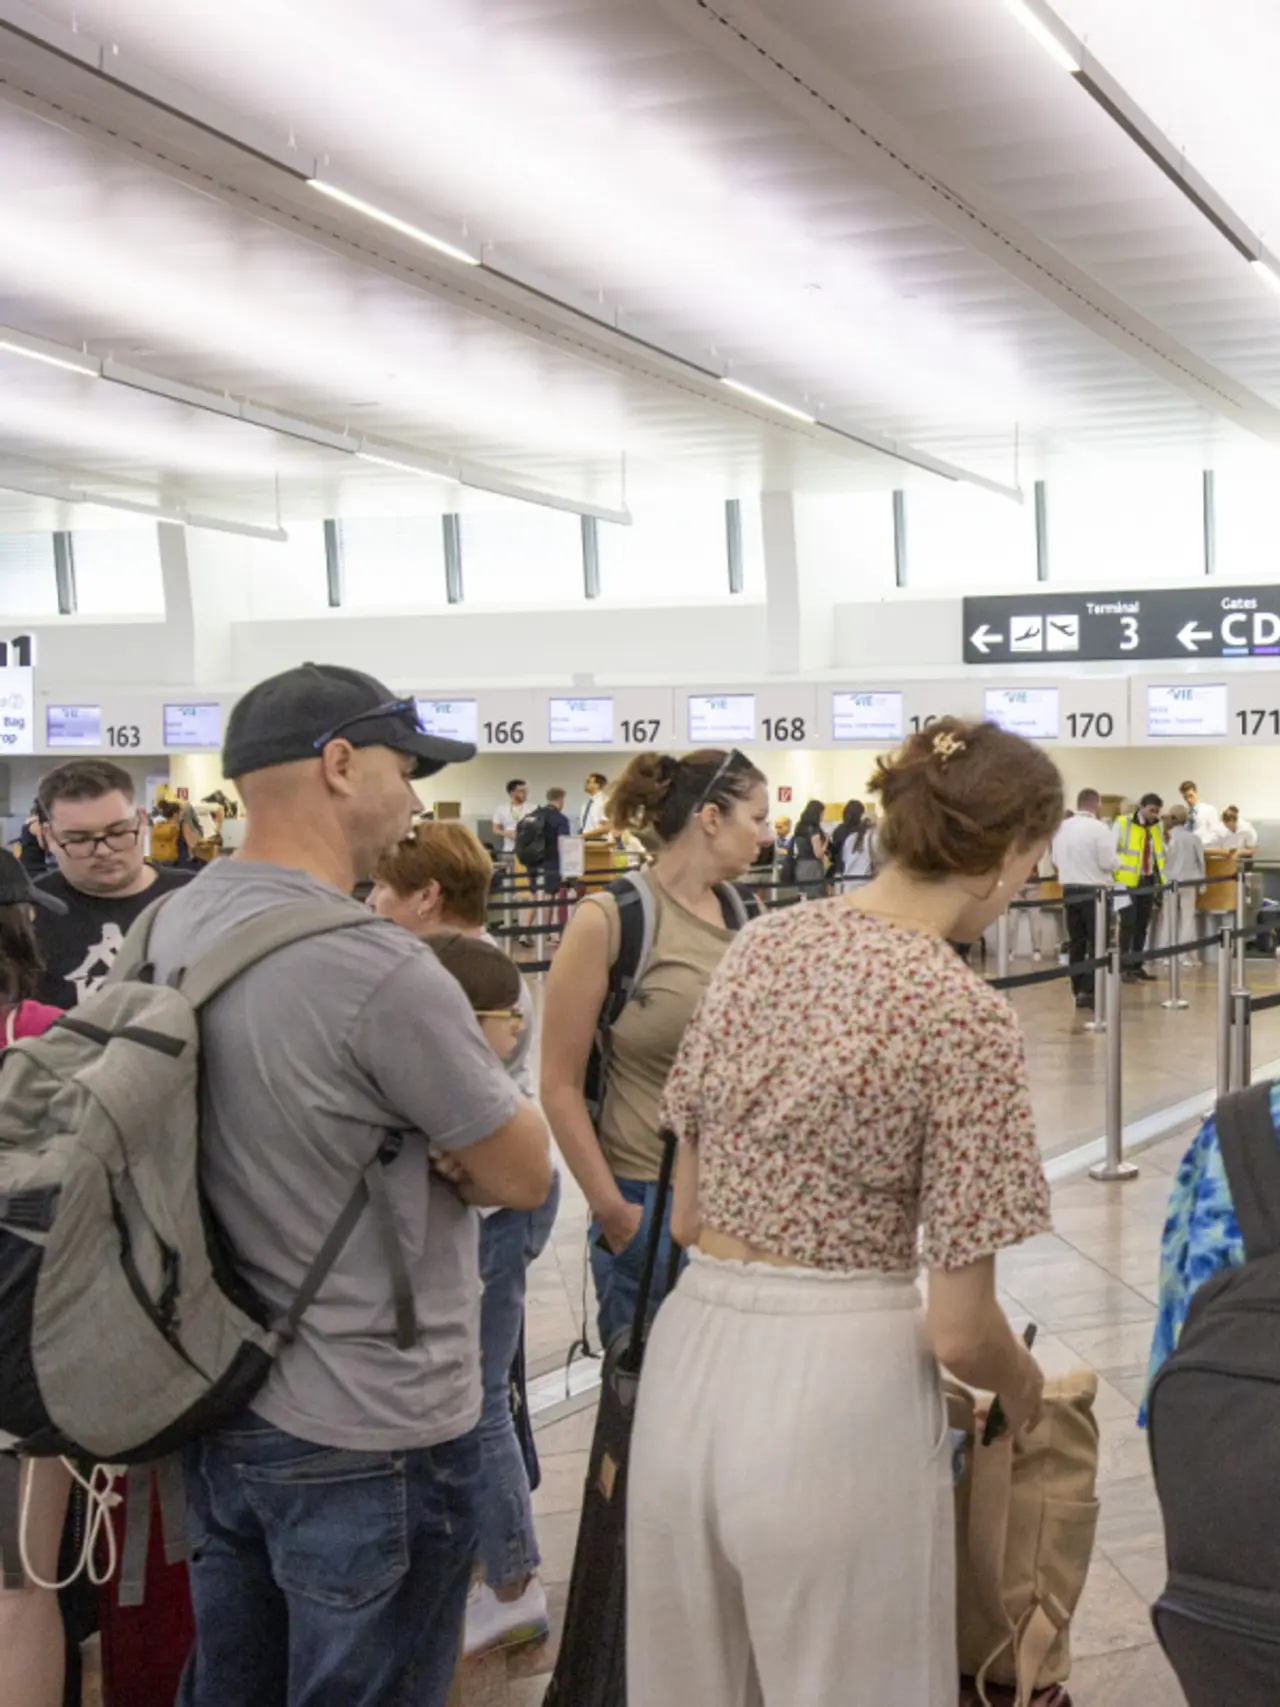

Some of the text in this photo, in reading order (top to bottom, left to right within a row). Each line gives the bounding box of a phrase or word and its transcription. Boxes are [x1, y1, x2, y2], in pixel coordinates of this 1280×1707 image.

[1085, 601, 1140, 615] Terminal
[1220, 597, 1258, 610] Gates
[1120, 616, 1140, 650] 3
[484, 721, 524, 744] 166
[620, 719, 661, 743] 167
[762, 717, 805, 742] 168
[1066, 712, 1113, 738] 170
[1236, 709, 1280, 735] 171
[107, 725, 141, 748] 163
